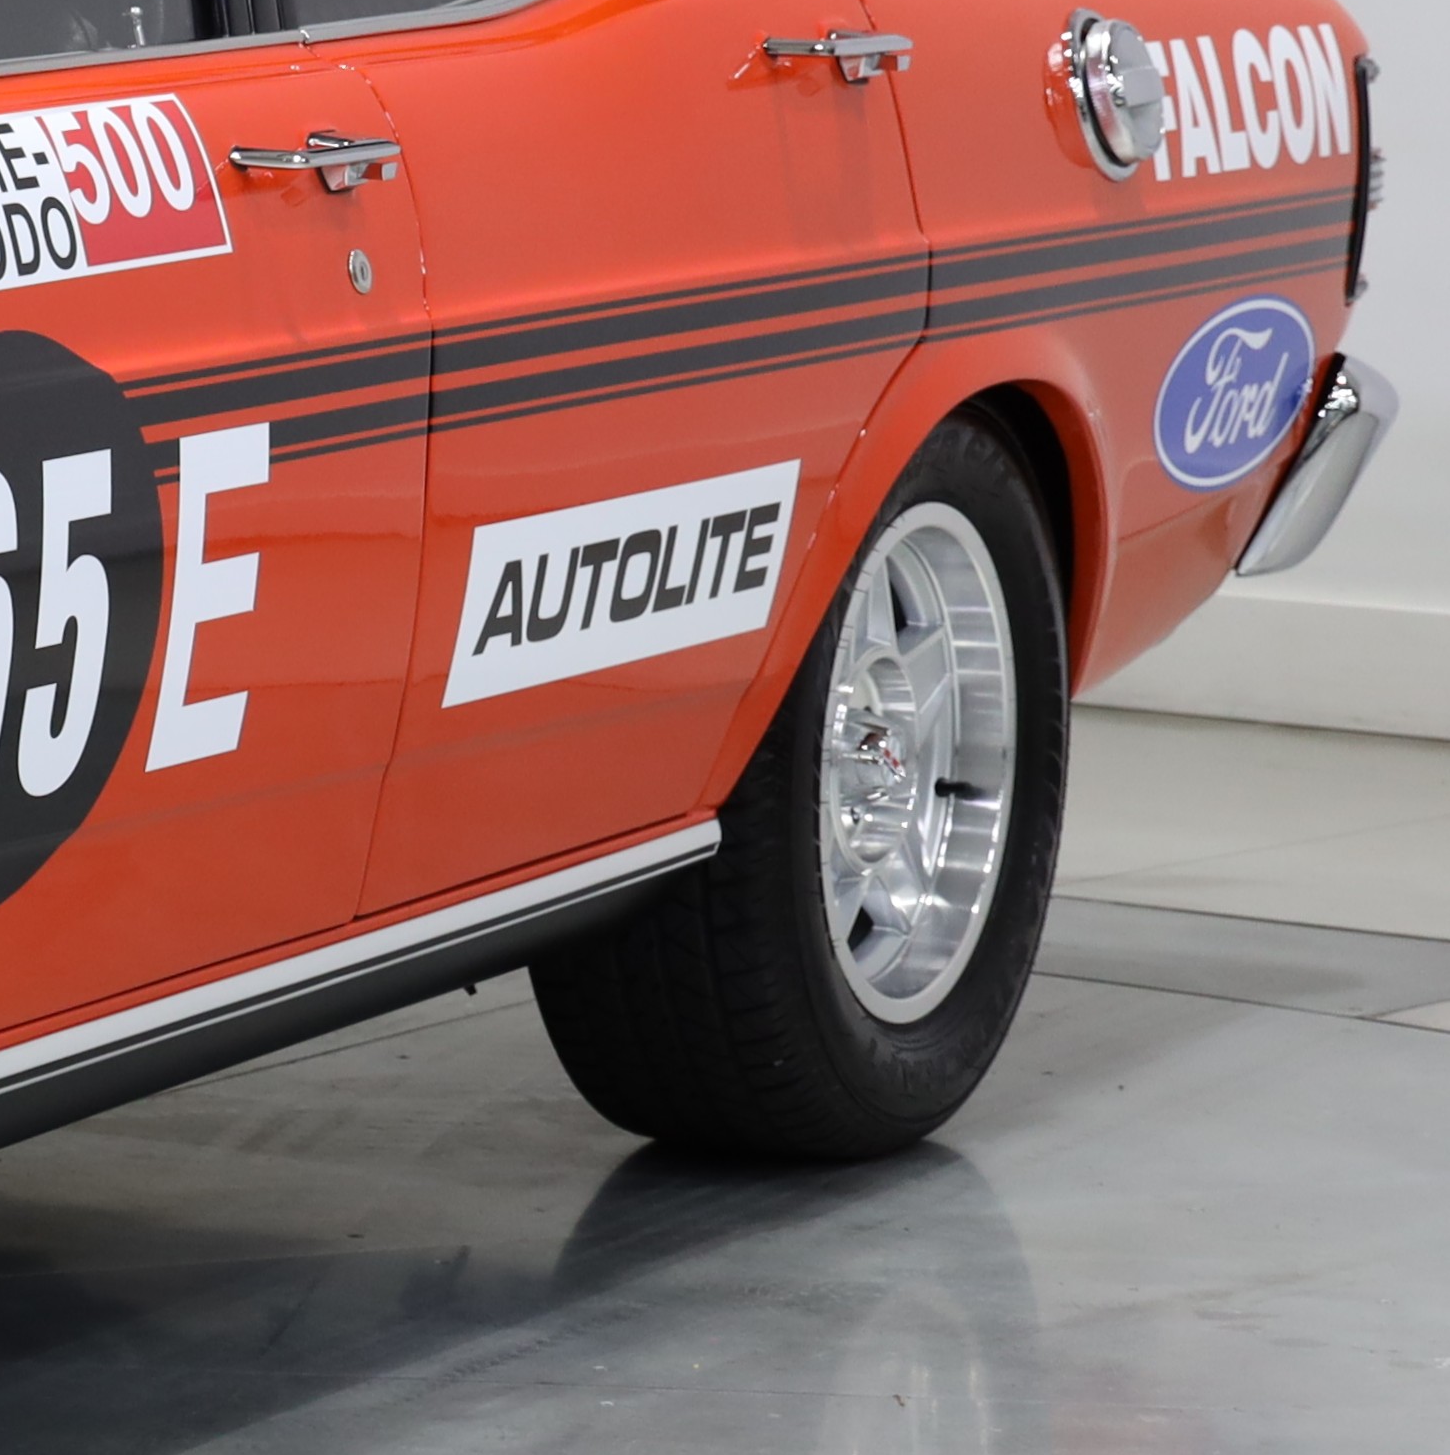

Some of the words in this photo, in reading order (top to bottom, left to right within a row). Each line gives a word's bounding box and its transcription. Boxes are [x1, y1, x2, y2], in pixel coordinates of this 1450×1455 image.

[52, 100, 195, 226] 500
[1183, 327, 1289, 454] Ford
[145, 421, 270, 772] E
[472, 501, 781, 656] AUTOLITE
